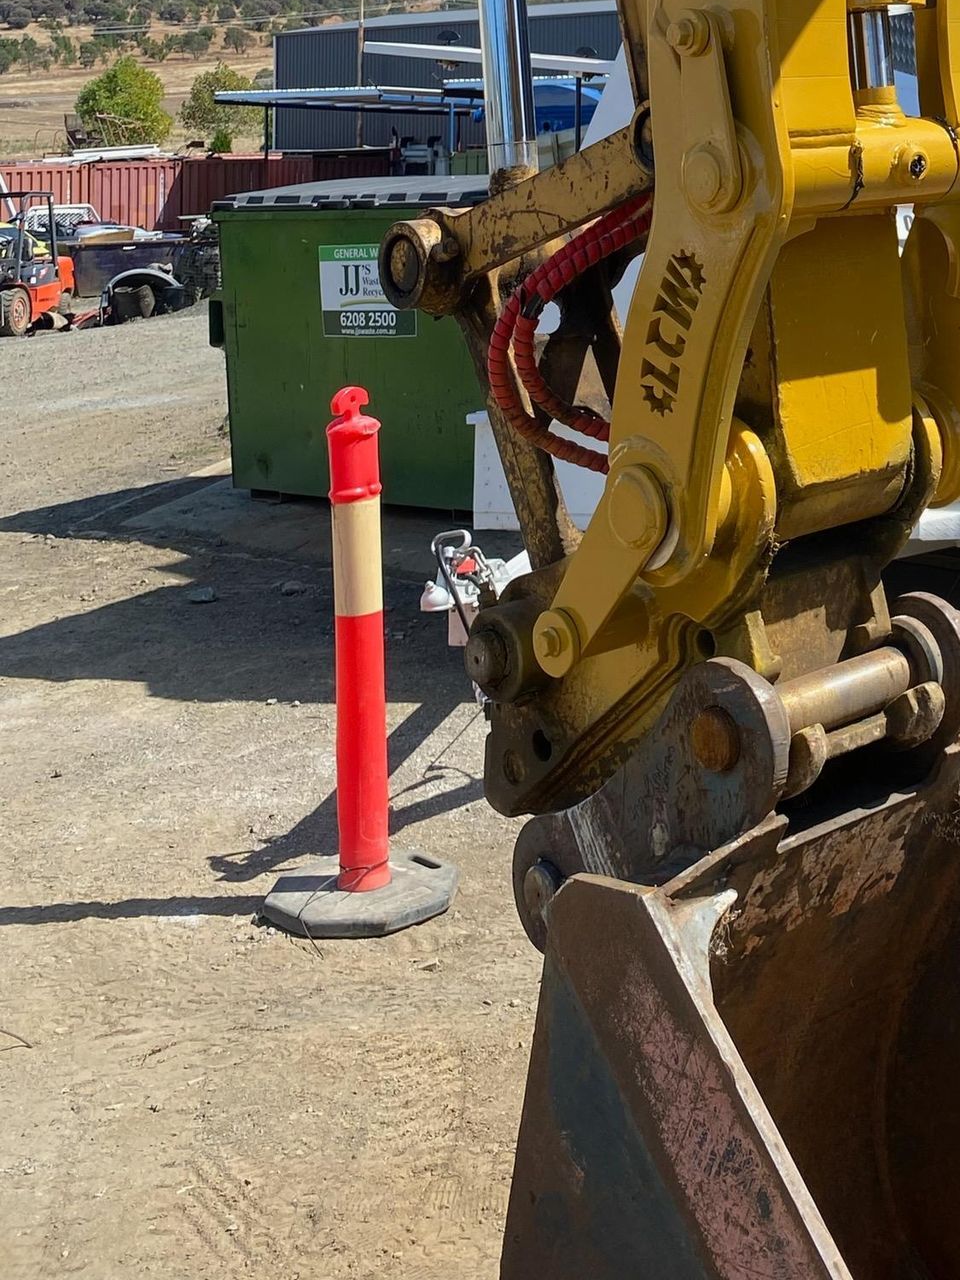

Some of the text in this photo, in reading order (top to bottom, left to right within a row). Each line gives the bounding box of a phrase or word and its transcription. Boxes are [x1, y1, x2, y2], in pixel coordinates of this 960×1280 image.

[334, 248, 368, 258] GENERAL
[362, 277, 378, 285] Wast
[363, 288, 385, 297] Recyc
[340, 312, 396, 326] 6208 2500
